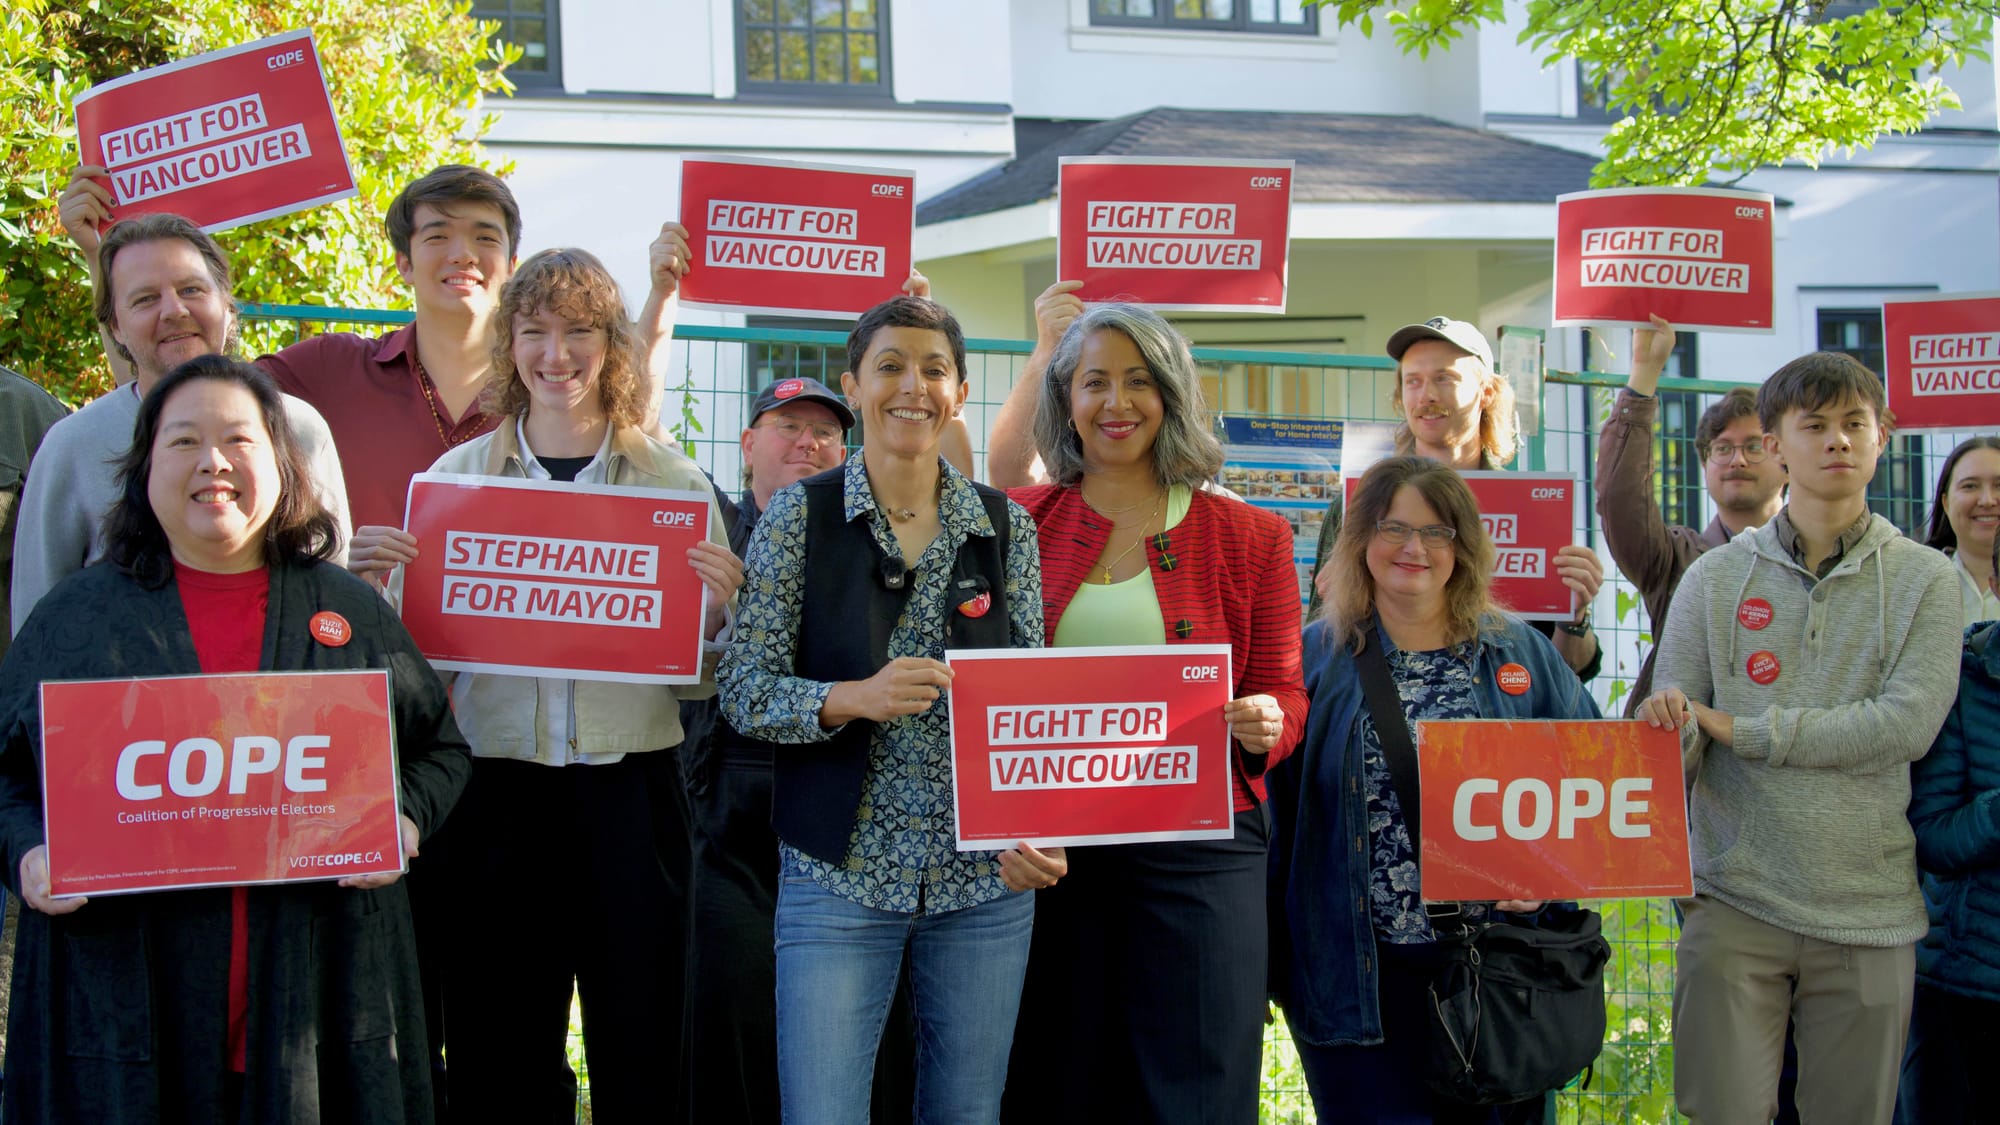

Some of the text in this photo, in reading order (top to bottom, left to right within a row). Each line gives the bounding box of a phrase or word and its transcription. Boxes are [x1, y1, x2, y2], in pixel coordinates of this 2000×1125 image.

[266, 50, 304, 69] COPE
[106, 99, 262, 163] FIGHT FOR
[117, 130, 303, 200] VANCOUVER
[871, 183, 904, 196] COPE
[1250, 176, 1282, 188] COPE
[711, 204, 854, 235] FIGHT FOR
[1091, 205, 1232, 230] FIGHT FOR
[1735, 206, 1765, 219] COPE
[1092, 241, 1255, 266] VANCOUVER
[1585, 230, 1719, 254] FIGHT FOR
[711, 240, 879, 273] VANCOUVER
[1586, 263, 1743, 289] VANCOUVER
[1914, 336, 1992, 360] FIGHT
[1531, 488, 1565, 499] COPE
[652, 510, 696, 526] COPE
[1481, 518, 1513, 539] OR
[449, 536, 650, 577] STEPHANIE
[447, 582, 654, 622] FOR MAYOR
[320, 625, 342, 637] MAH
[1182, 665, 1219, 680] COPE
[993, 707, 1163, 739] FIGHT FOR
[115, 735, 331, 801] COPE
[995, 751, 1191, 785] VANCOUVER
[117, 803, 336, 824] Coalition of Progressive Electors
[1453, 777, 1653, 841] COPE
[289, 851, 383, 868] VOTECOPE.CA
